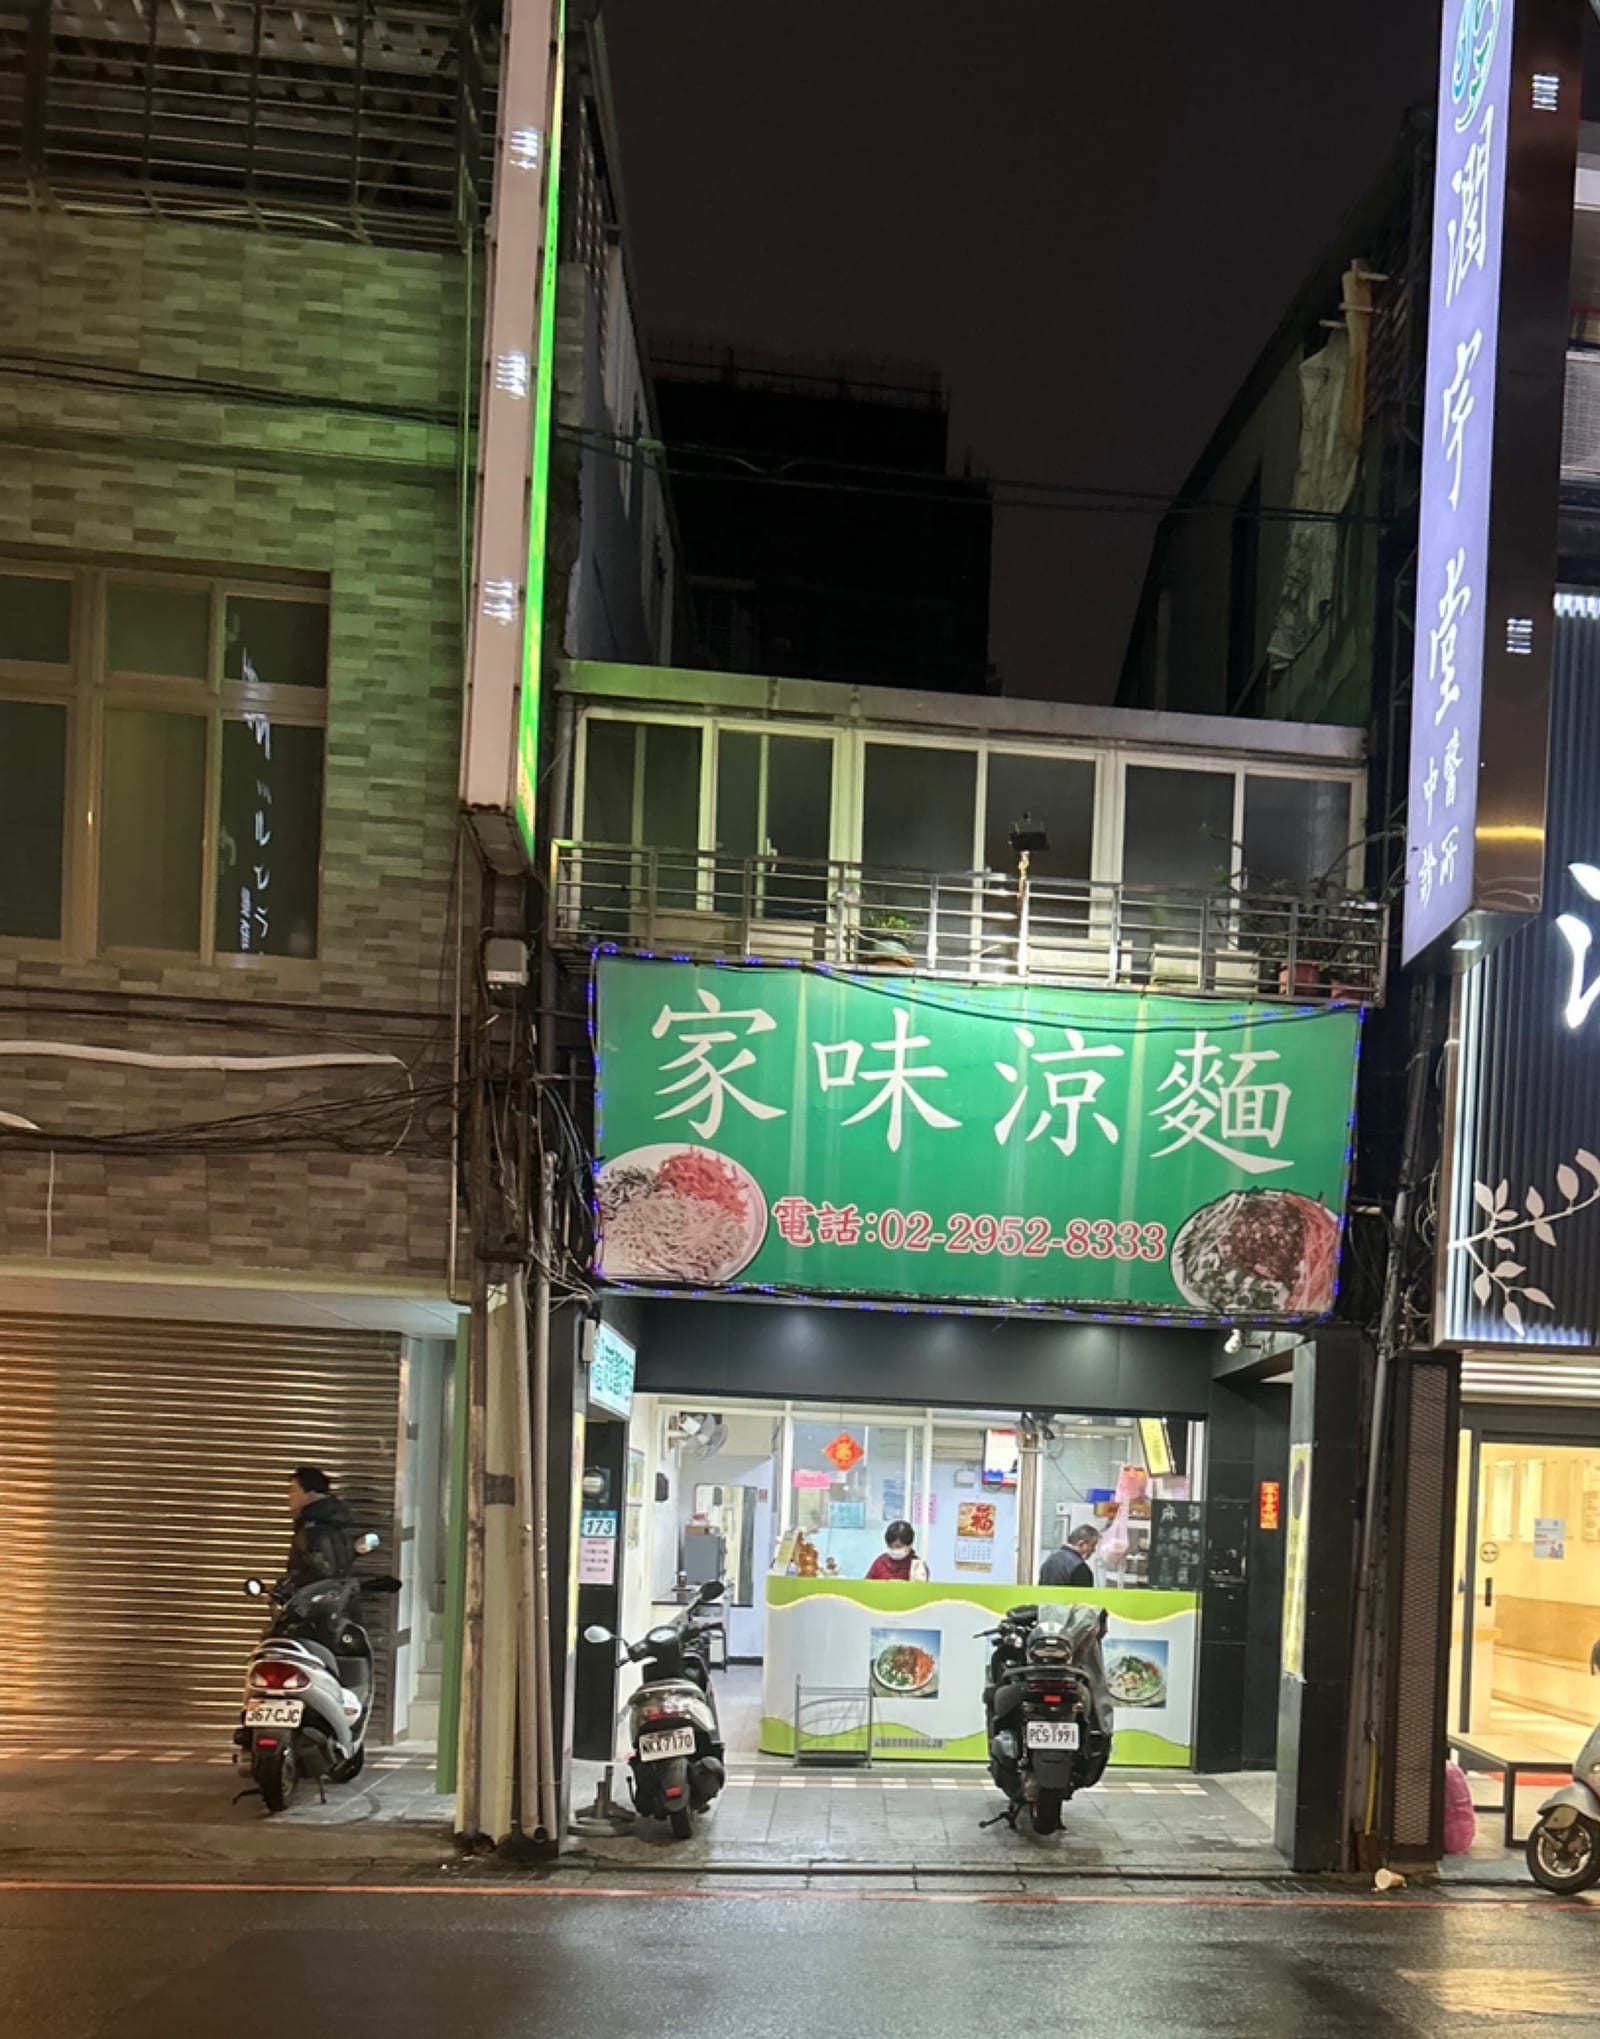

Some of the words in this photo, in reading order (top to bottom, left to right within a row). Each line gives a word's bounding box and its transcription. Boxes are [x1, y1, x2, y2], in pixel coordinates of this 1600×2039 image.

[651, 988, 1295, 1175] 家味涼麵
[771, 1197, 1168, 1263] 電話:02-2952-8333
[586, 1519, 613, 1535] 173
